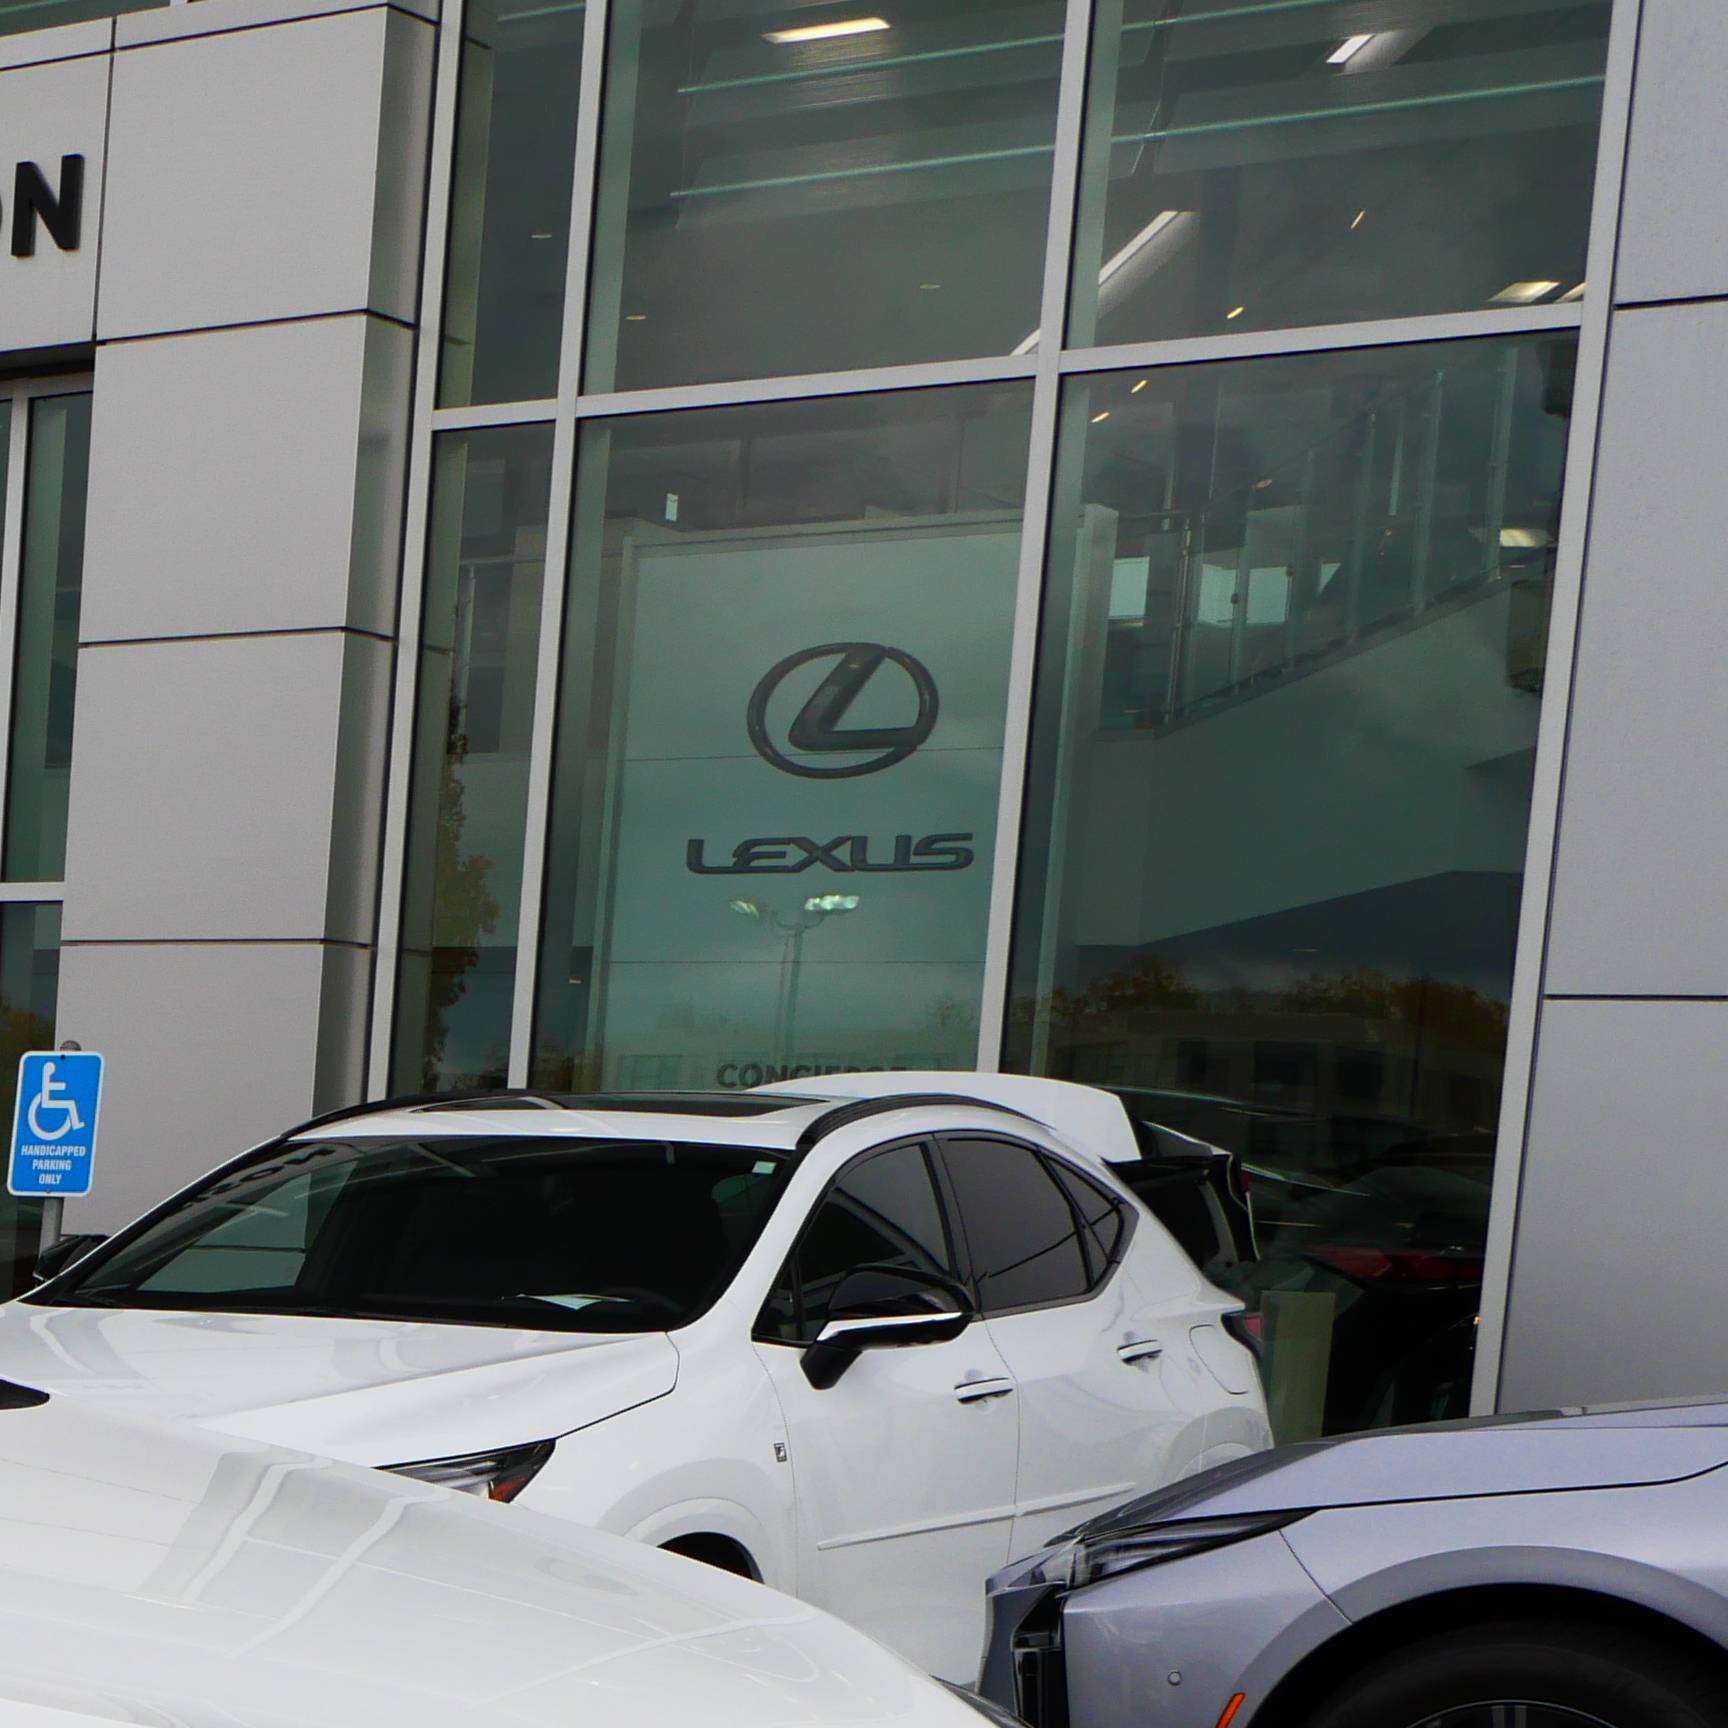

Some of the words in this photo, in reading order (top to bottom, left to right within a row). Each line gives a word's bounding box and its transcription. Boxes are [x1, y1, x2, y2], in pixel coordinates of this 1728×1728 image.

[687, 832, 974, 874] LEXUS
[21, 1145, 86, 1156] HANDICAPPED
[32, 1159, 72, 1170] PARKING
[38, 1174, 62, 1184] ONLY
